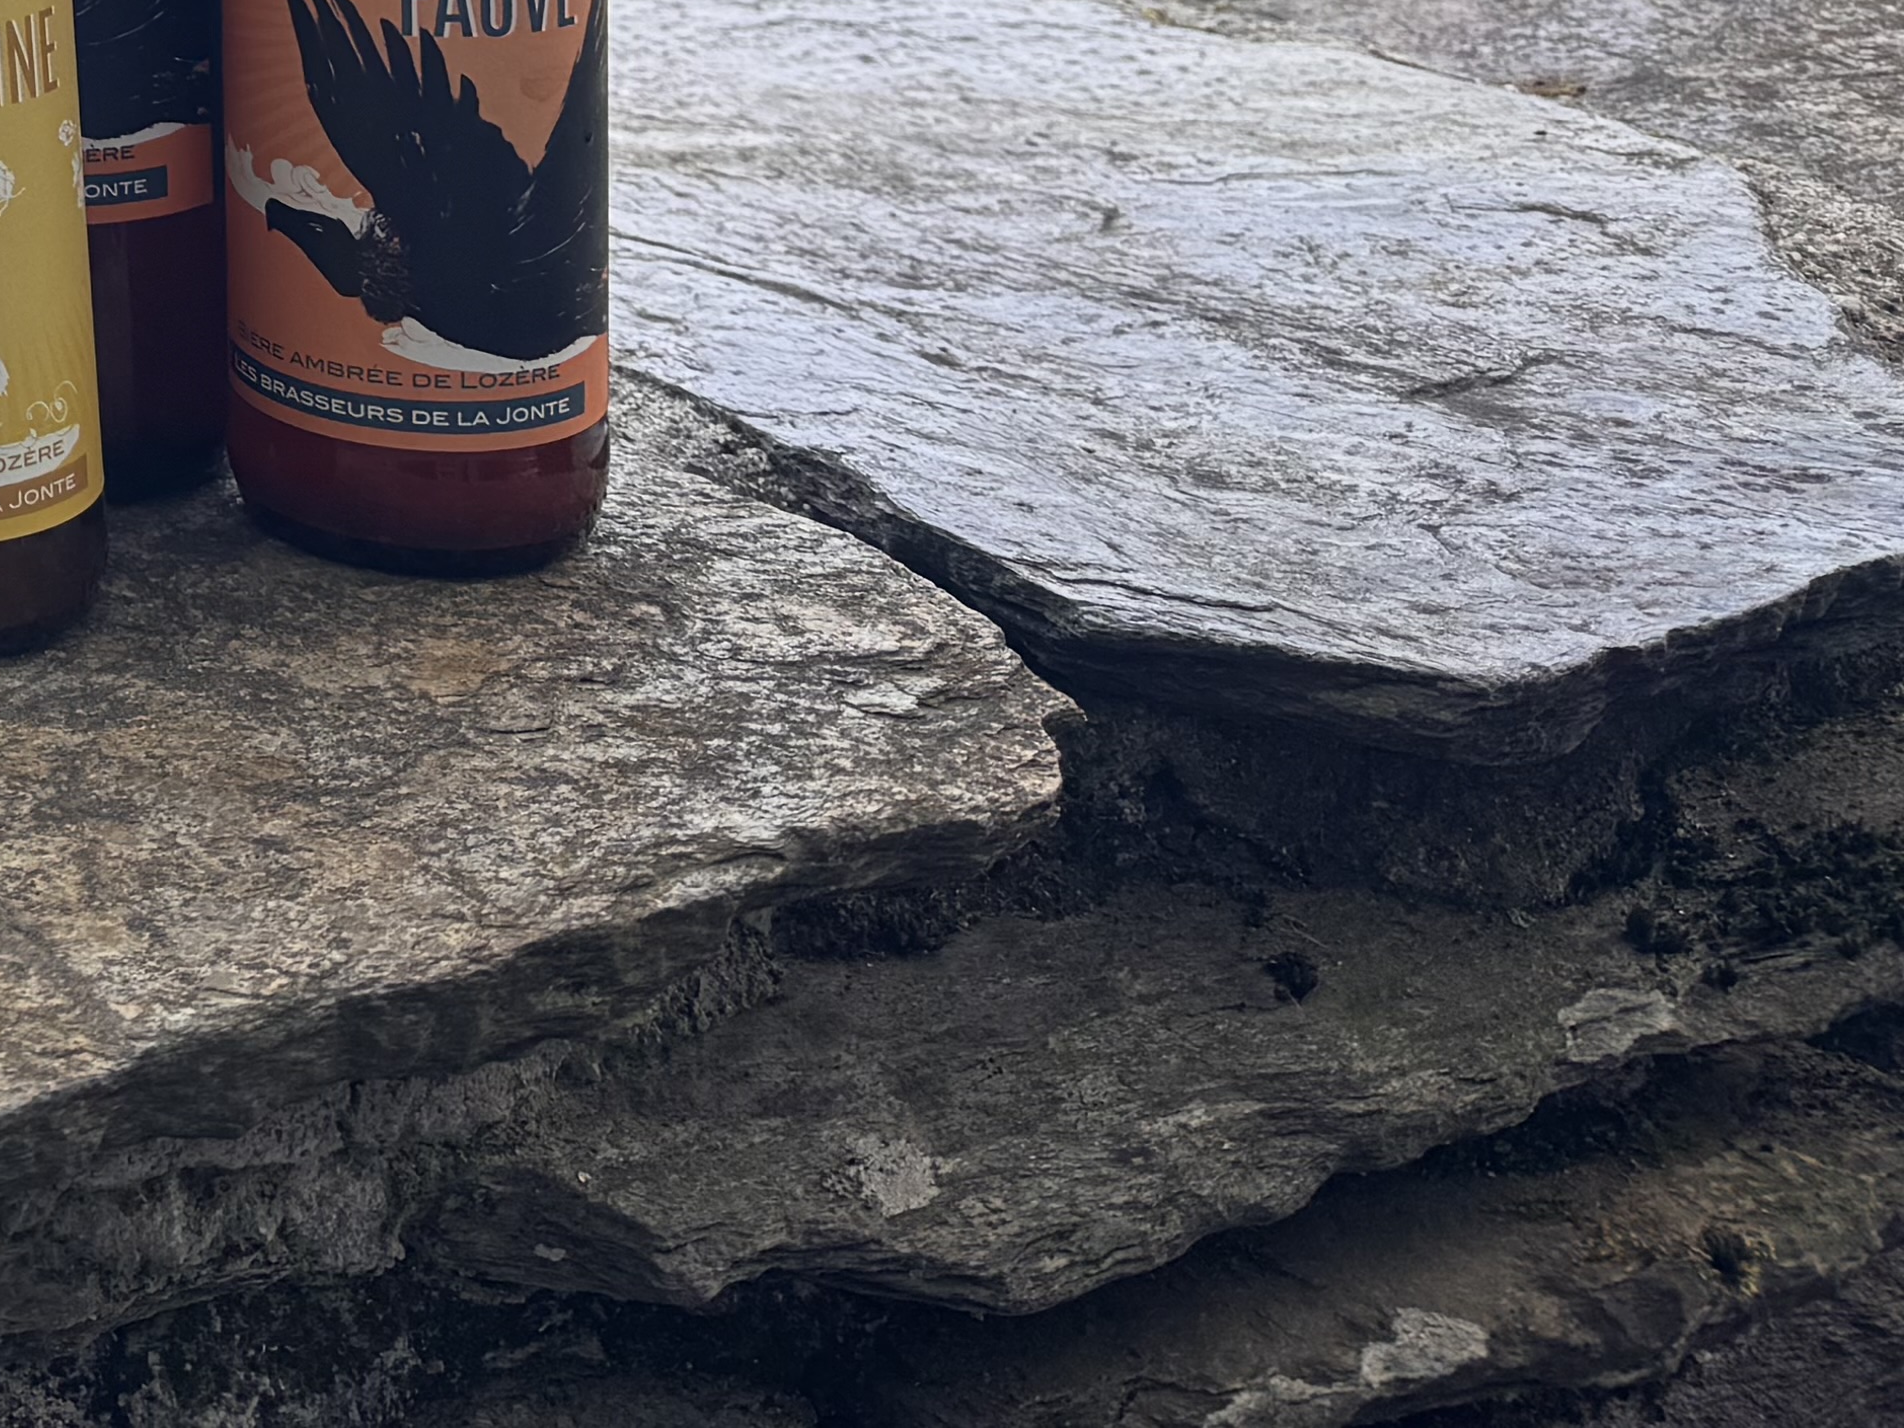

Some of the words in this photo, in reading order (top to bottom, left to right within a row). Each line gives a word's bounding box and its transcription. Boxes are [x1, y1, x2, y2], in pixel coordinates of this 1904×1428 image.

[85, 144, 136, 162] ÈRE
[84, 179, 148, 198] ONTE
[290, 351, 403, 387] AMBRÉE
[412, 373, 452, 389] DE
[460, 360, 561, 390] LOZÈRE
[235, 351, 258, 383] LES
[260, 374, 404, 424] BRASSEURS
[411, 410, 450, 426] DE
[457, 409, 491, 427] LA
[496, 397, 571, 425] JONTE
[9, 473, 77, 509] JONTE
